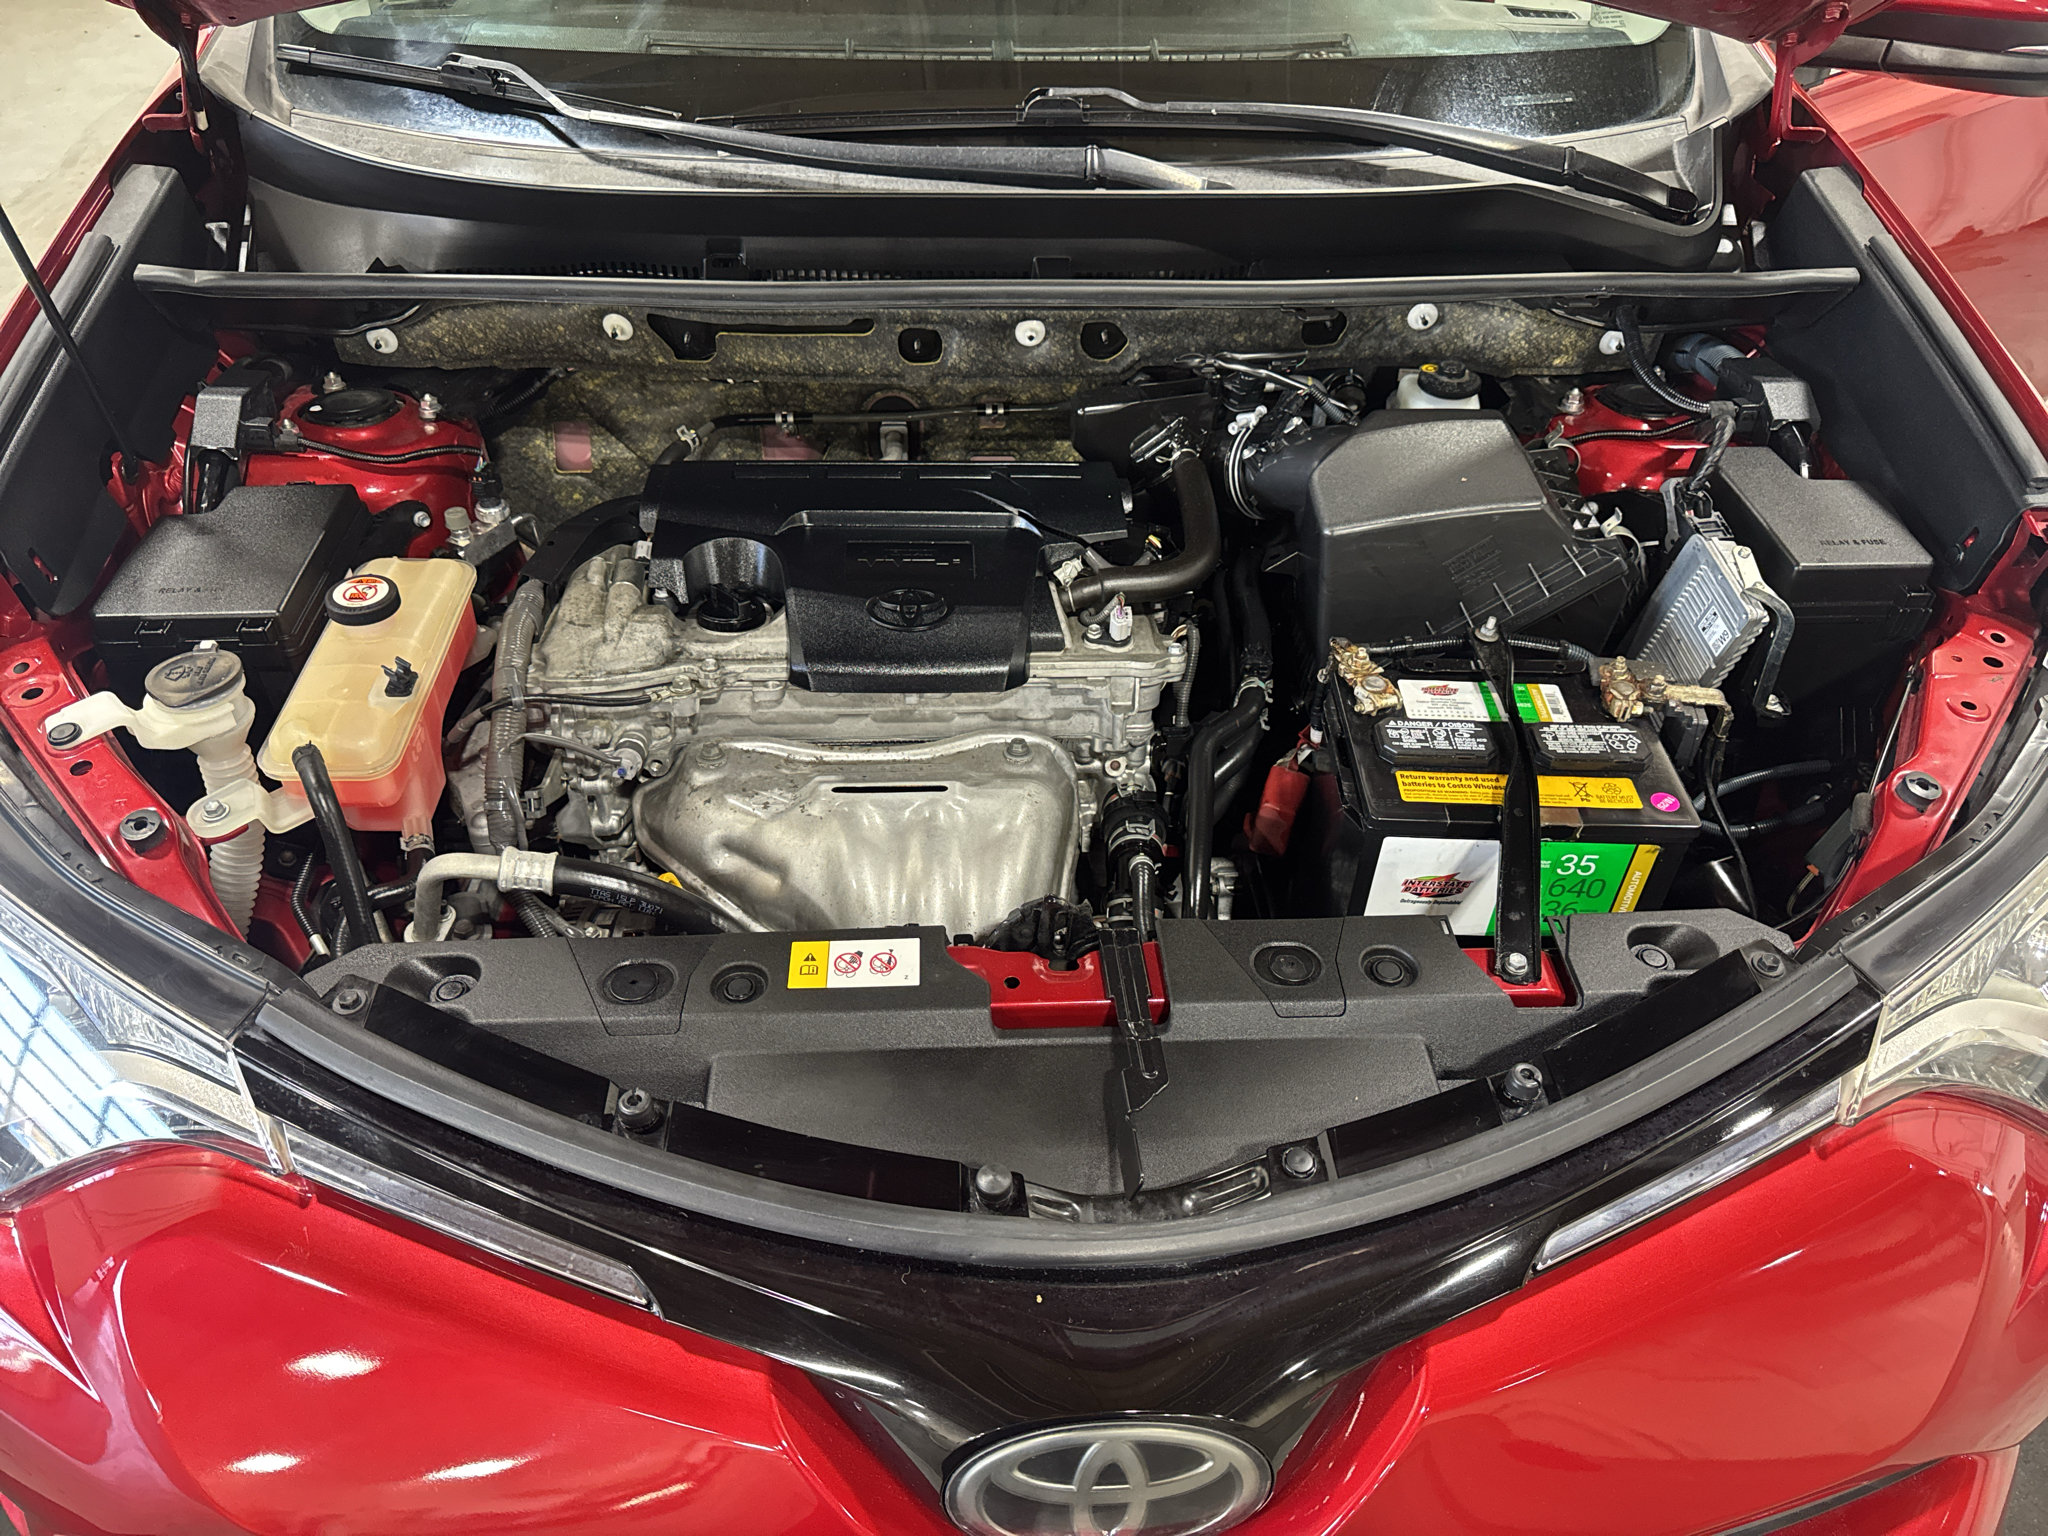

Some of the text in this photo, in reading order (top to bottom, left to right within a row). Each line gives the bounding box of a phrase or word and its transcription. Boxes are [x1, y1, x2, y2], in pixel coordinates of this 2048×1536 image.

[1427, 775, 1463, 783] warranty
[1402, 780, 1437, 788] batteries
[1556, 854, 1599, 876] 35
[1403, 879, 1473, 888] INTERSTATE
[1403, 886, 1464, 894] BATTERIES
[1548, 878, 1606, 899] 640
